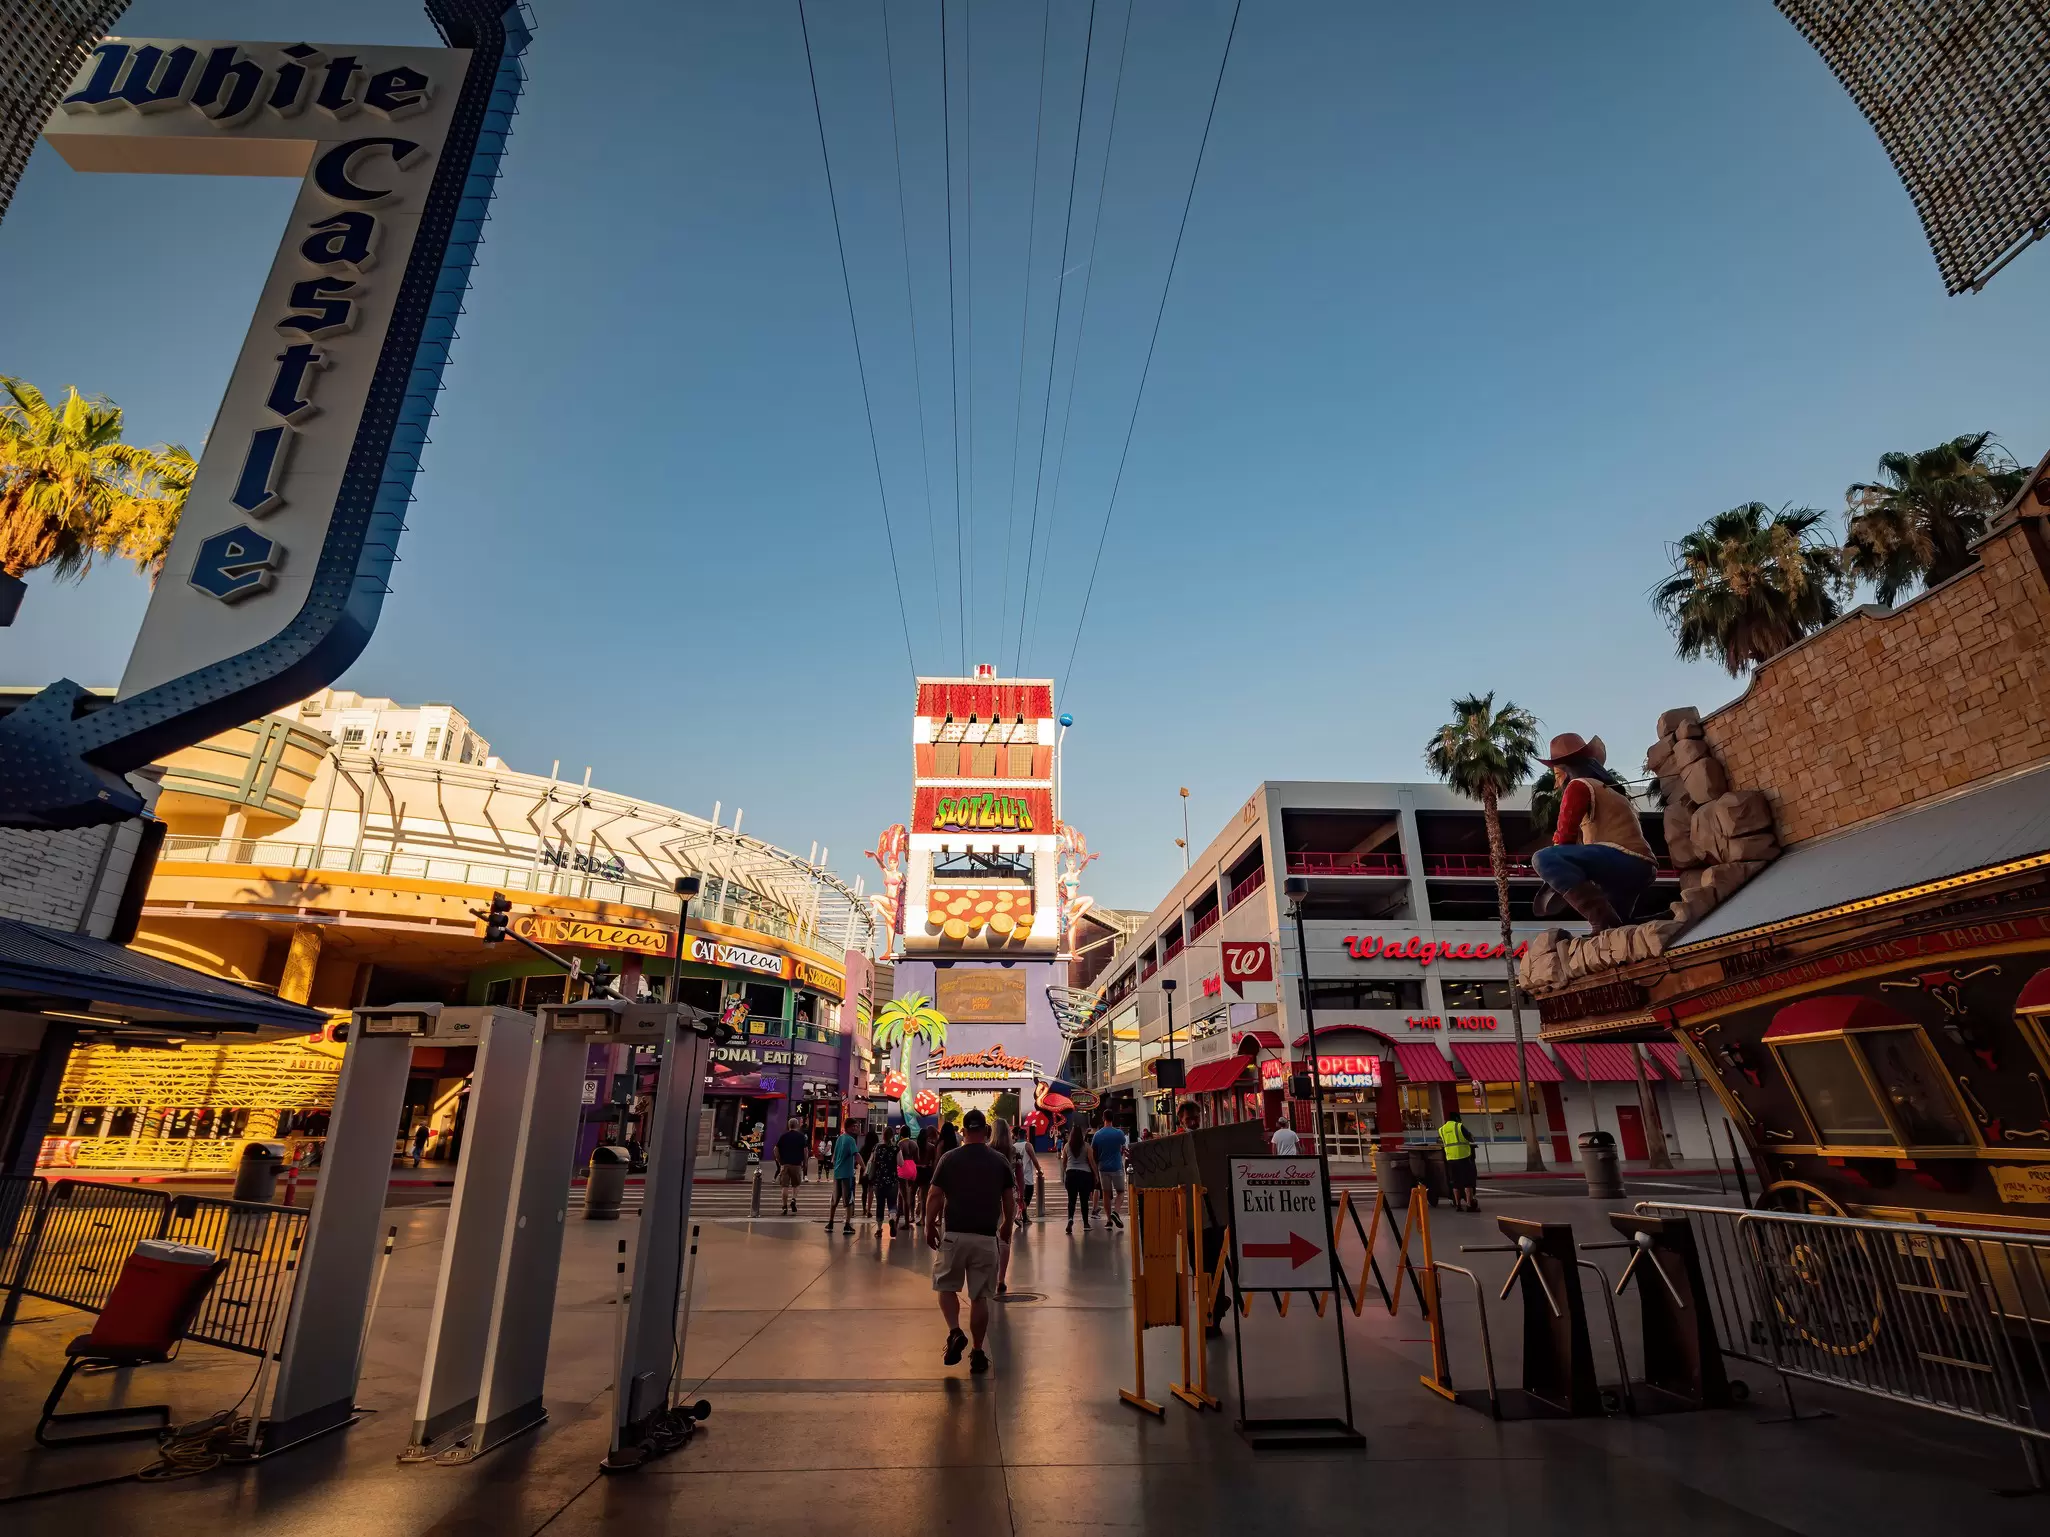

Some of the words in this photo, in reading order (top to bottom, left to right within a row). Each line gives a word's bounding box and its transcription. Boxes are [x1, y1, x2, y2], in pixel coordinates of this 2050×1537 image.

[62, 42, 430, 119] White
[188, 137, 420, 602] Castle
[932, 792, 1034, 831] SLOTZILLA
[569, 923, 666, 950] meow
[726, 947, 782, 972] meow
[1226, 946, 1265, 975] W
[1342, 935, 1529, 966] Walgreens
[1699, 979, 1762, 1010] EUROPEAN
[1833, 939, 1908, 968] PALMS
[1939, 919, 2021, 948] TAROT
[1406, 1016, 1442, 1030] 1-HR
[930, 1046, 987, 1076] Fremont
[983, 1043, 1029, 1072] Street
[1317, 1058, 1371, 1074] OPEN
[951, 1071, 1009, 1081] EXPERIENCE
[1332, 1074, 1373, 1087] HOURS
[1236, 1164, 1281, 1180] Fremont
[1283, 1164, 1316, 1179] Street
[1242, 1188, 1275, 1212] Exit
[1278, 1188, 1316, 1212] Here
